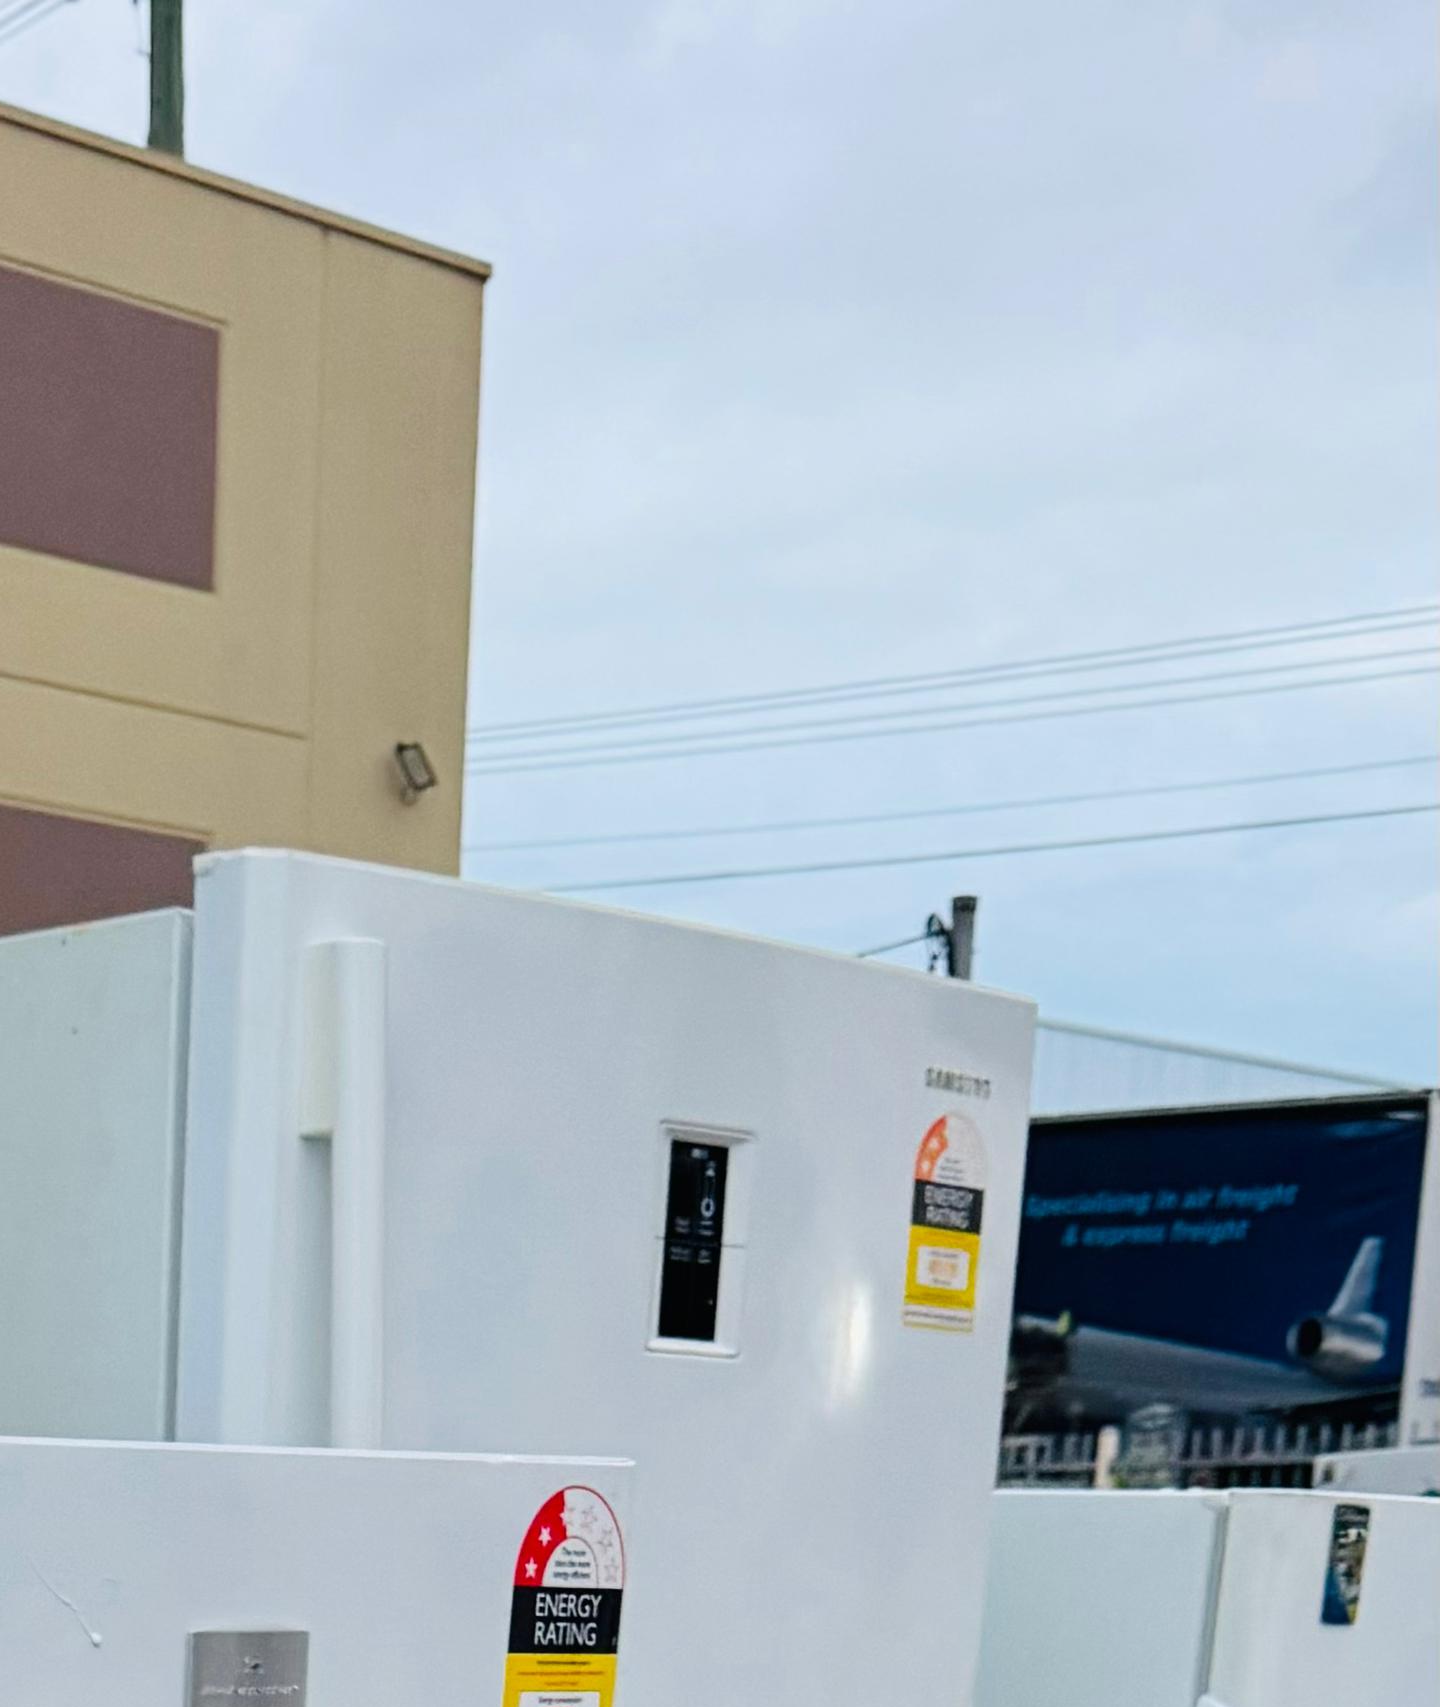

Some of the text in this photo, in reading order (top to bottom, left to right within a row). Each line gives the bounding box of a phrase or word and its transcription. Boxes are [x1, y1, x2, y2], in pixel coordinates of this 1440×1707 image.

[1216, 1183, 1299, 1212] freight
[1168, 1218, 1251, 1247] freight
[535, 1592, 602, 1618] ENERGY
[534, 1621, 597, 1647] RATING
